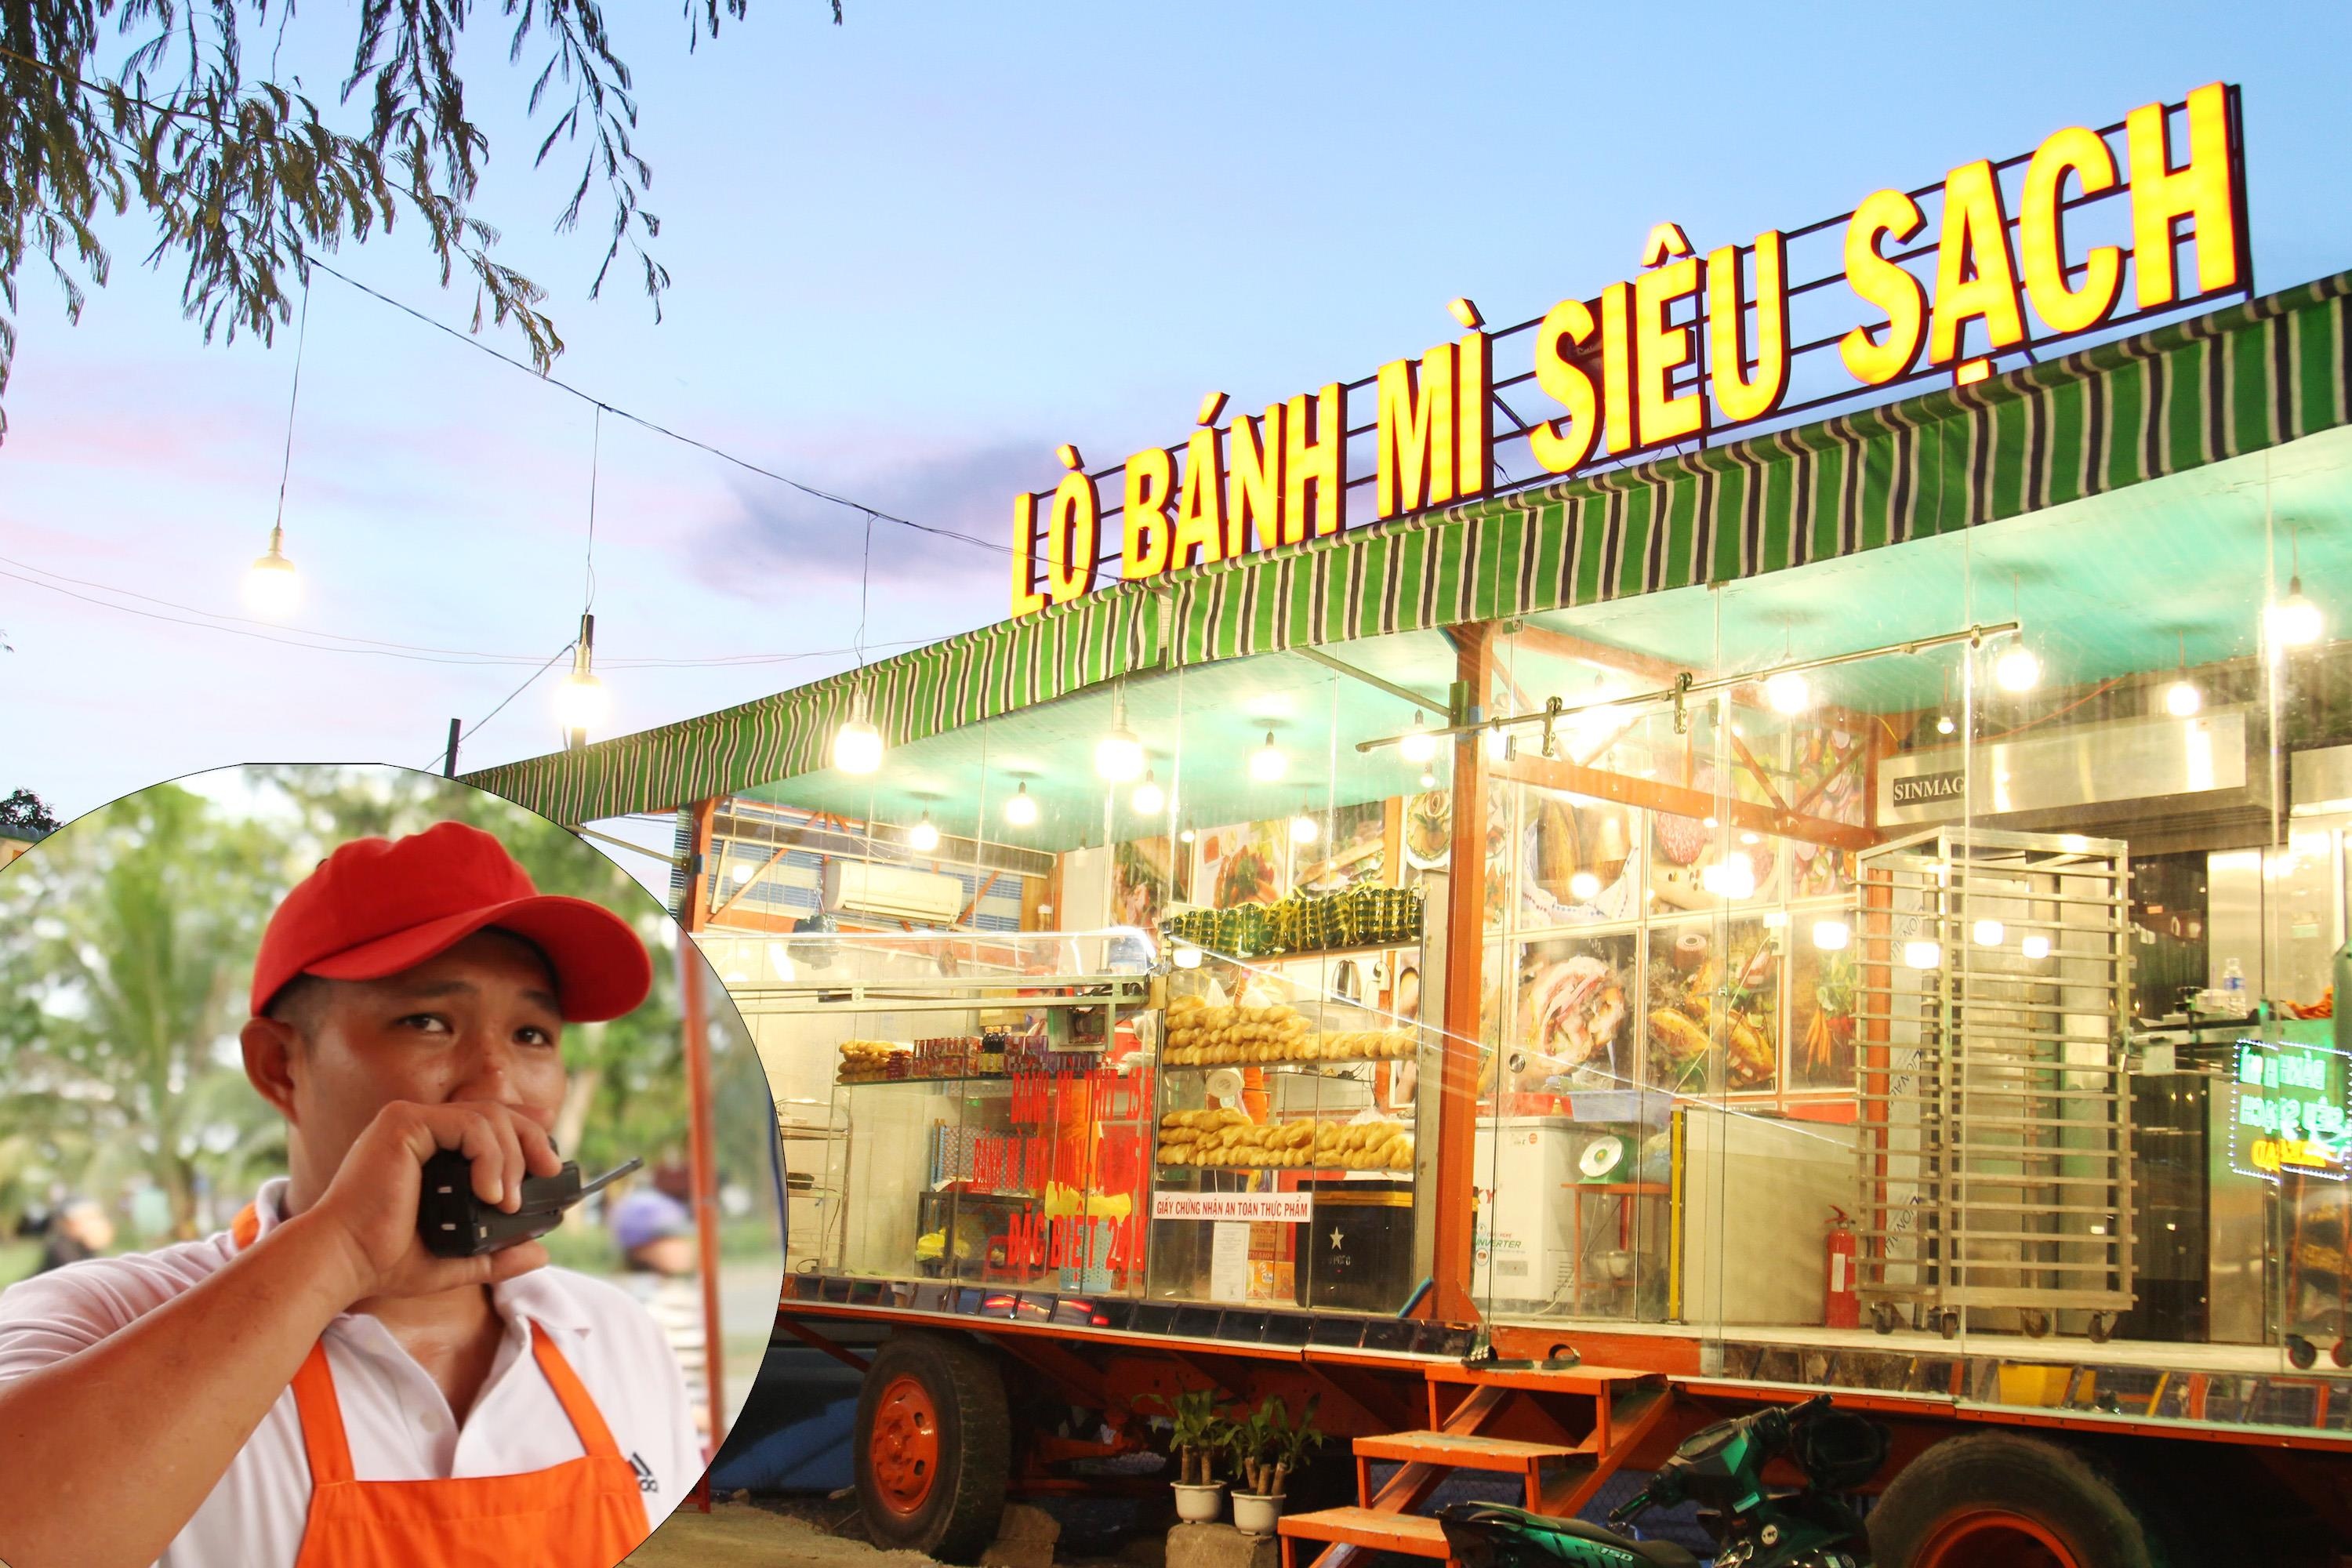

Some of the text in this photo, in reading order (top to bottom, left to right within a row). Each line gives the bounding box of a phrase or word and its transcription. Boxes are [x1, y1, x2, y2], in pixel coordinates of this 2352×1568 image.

[1011, 81, 2240, 618] LÒ BÁNH MÌ SIÊU SẠCH
[1894, 776, 1964, 800] SINMAG
[1011, 1058, 1051, 1123] BÁNH
[1156, 1196, 1308, 1219] GIẤY CHỨNG NHẬN AN TOÀN THỰC PHẨM
[1051, 1200, 1098, 1282] BIỆT
